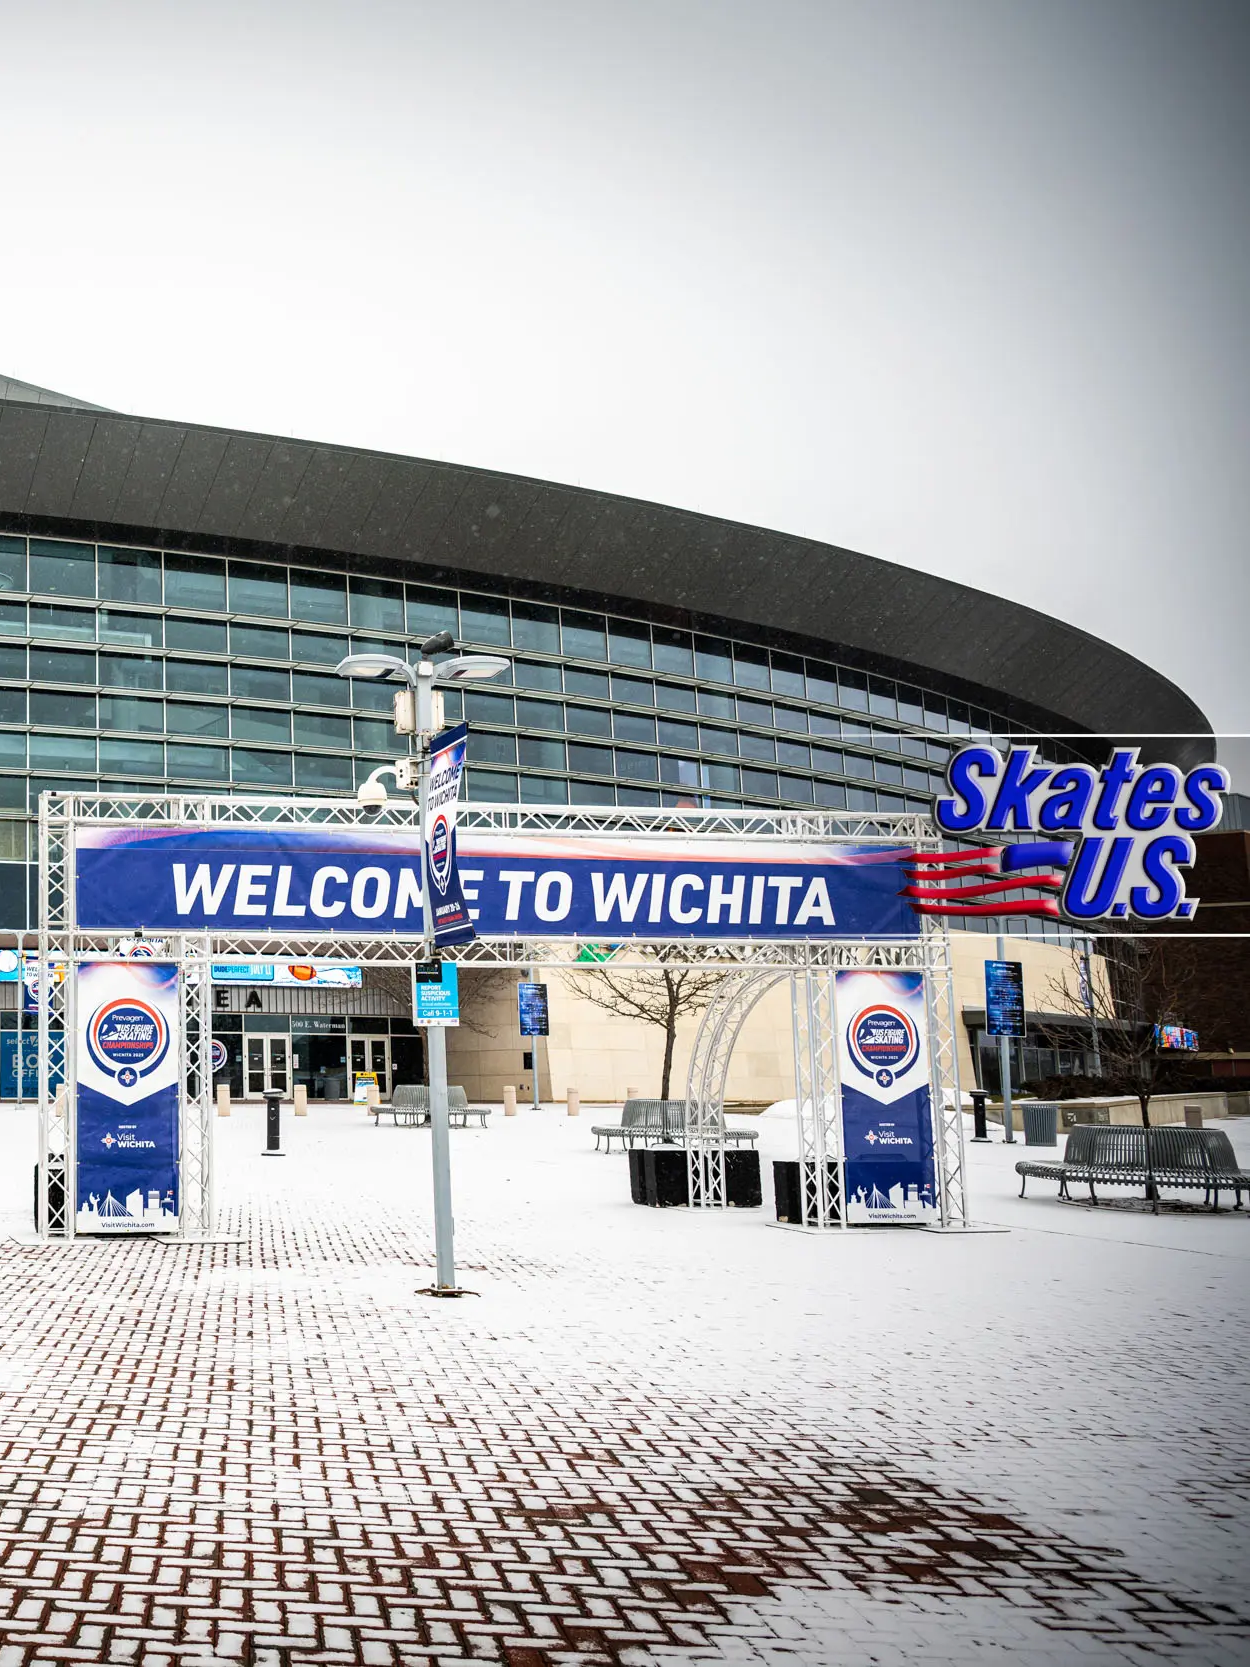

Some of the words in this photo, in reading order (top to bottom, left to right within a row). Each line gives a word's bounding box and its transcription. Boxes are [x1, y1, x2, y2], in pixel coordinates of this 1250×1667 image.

[430, 763, 461, 791] WELCOME
[427, 796, 434, 812] TO
[434, 784, 457, 807] WICHITA
[499, 871, 573, 921] TO
[592, 873, 836, 926] WICHITA
[130, 1024, 155, 1032] FIGURE
[291, 1020, 304, 1029] 500
[313, 1020, 346, 1029] Waterman
[117, 1031, 152, 1041] SKATING
[884, 1029, 906, 1037] FIGURE
[874, 1036, 904, 1044] SKATING
[102, 1041, 155, 1049] CHAMPIONSHIPS
